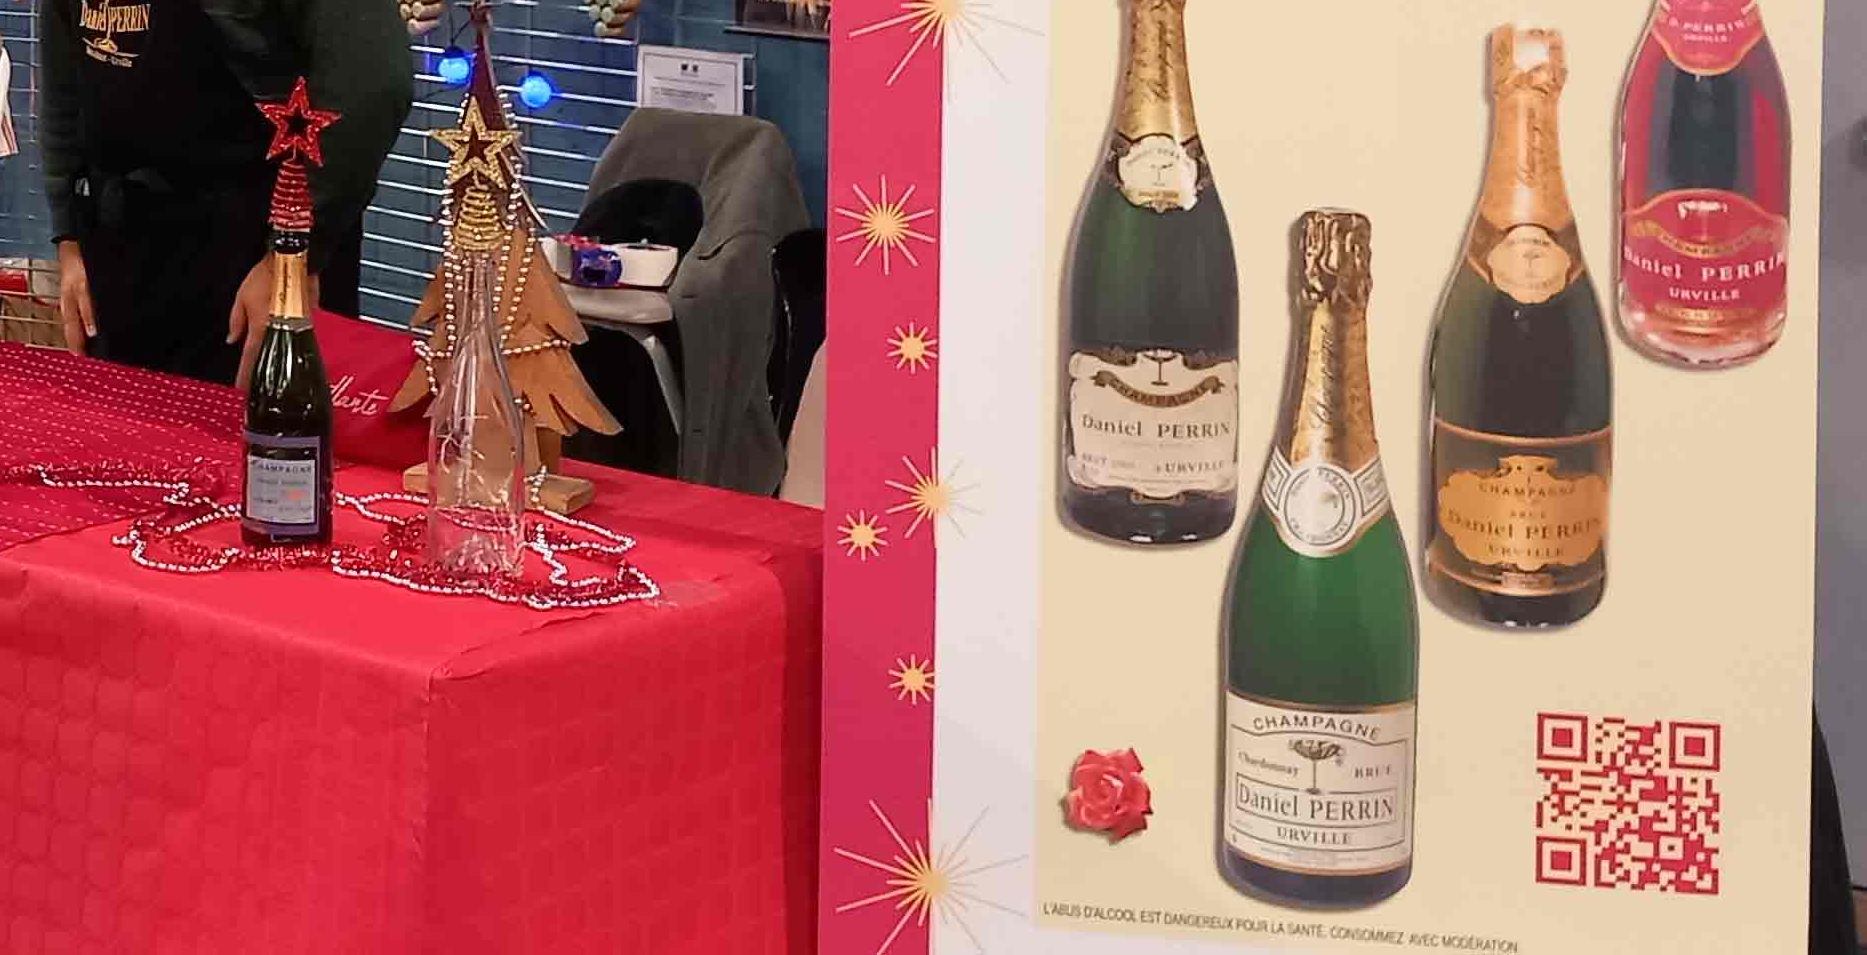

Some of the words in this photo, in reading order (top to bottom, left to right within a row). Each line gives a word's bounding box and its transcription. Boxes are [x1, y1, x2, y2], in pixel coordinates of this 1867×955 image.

[1082, 414, 1142, 437] Daniel
[1157, 420, 1230, 438] PERRIN
[1253, 714, 1381, 740] CHAMPAGNE
[1239, 783, 1299, 818] Daniel
[1309, 797, 1394, 822] PERRIN
[1277, 826, 1352, 845] URVILLE
[1140, 910, 1162, 924] EST
[1164, 912, 1234, 930] DANGEREUX
[1236, 918, 1268, 933] POUR
[1271, 921, 1285, 934] LA
[1409, 933, 1440, 949] AVEC
